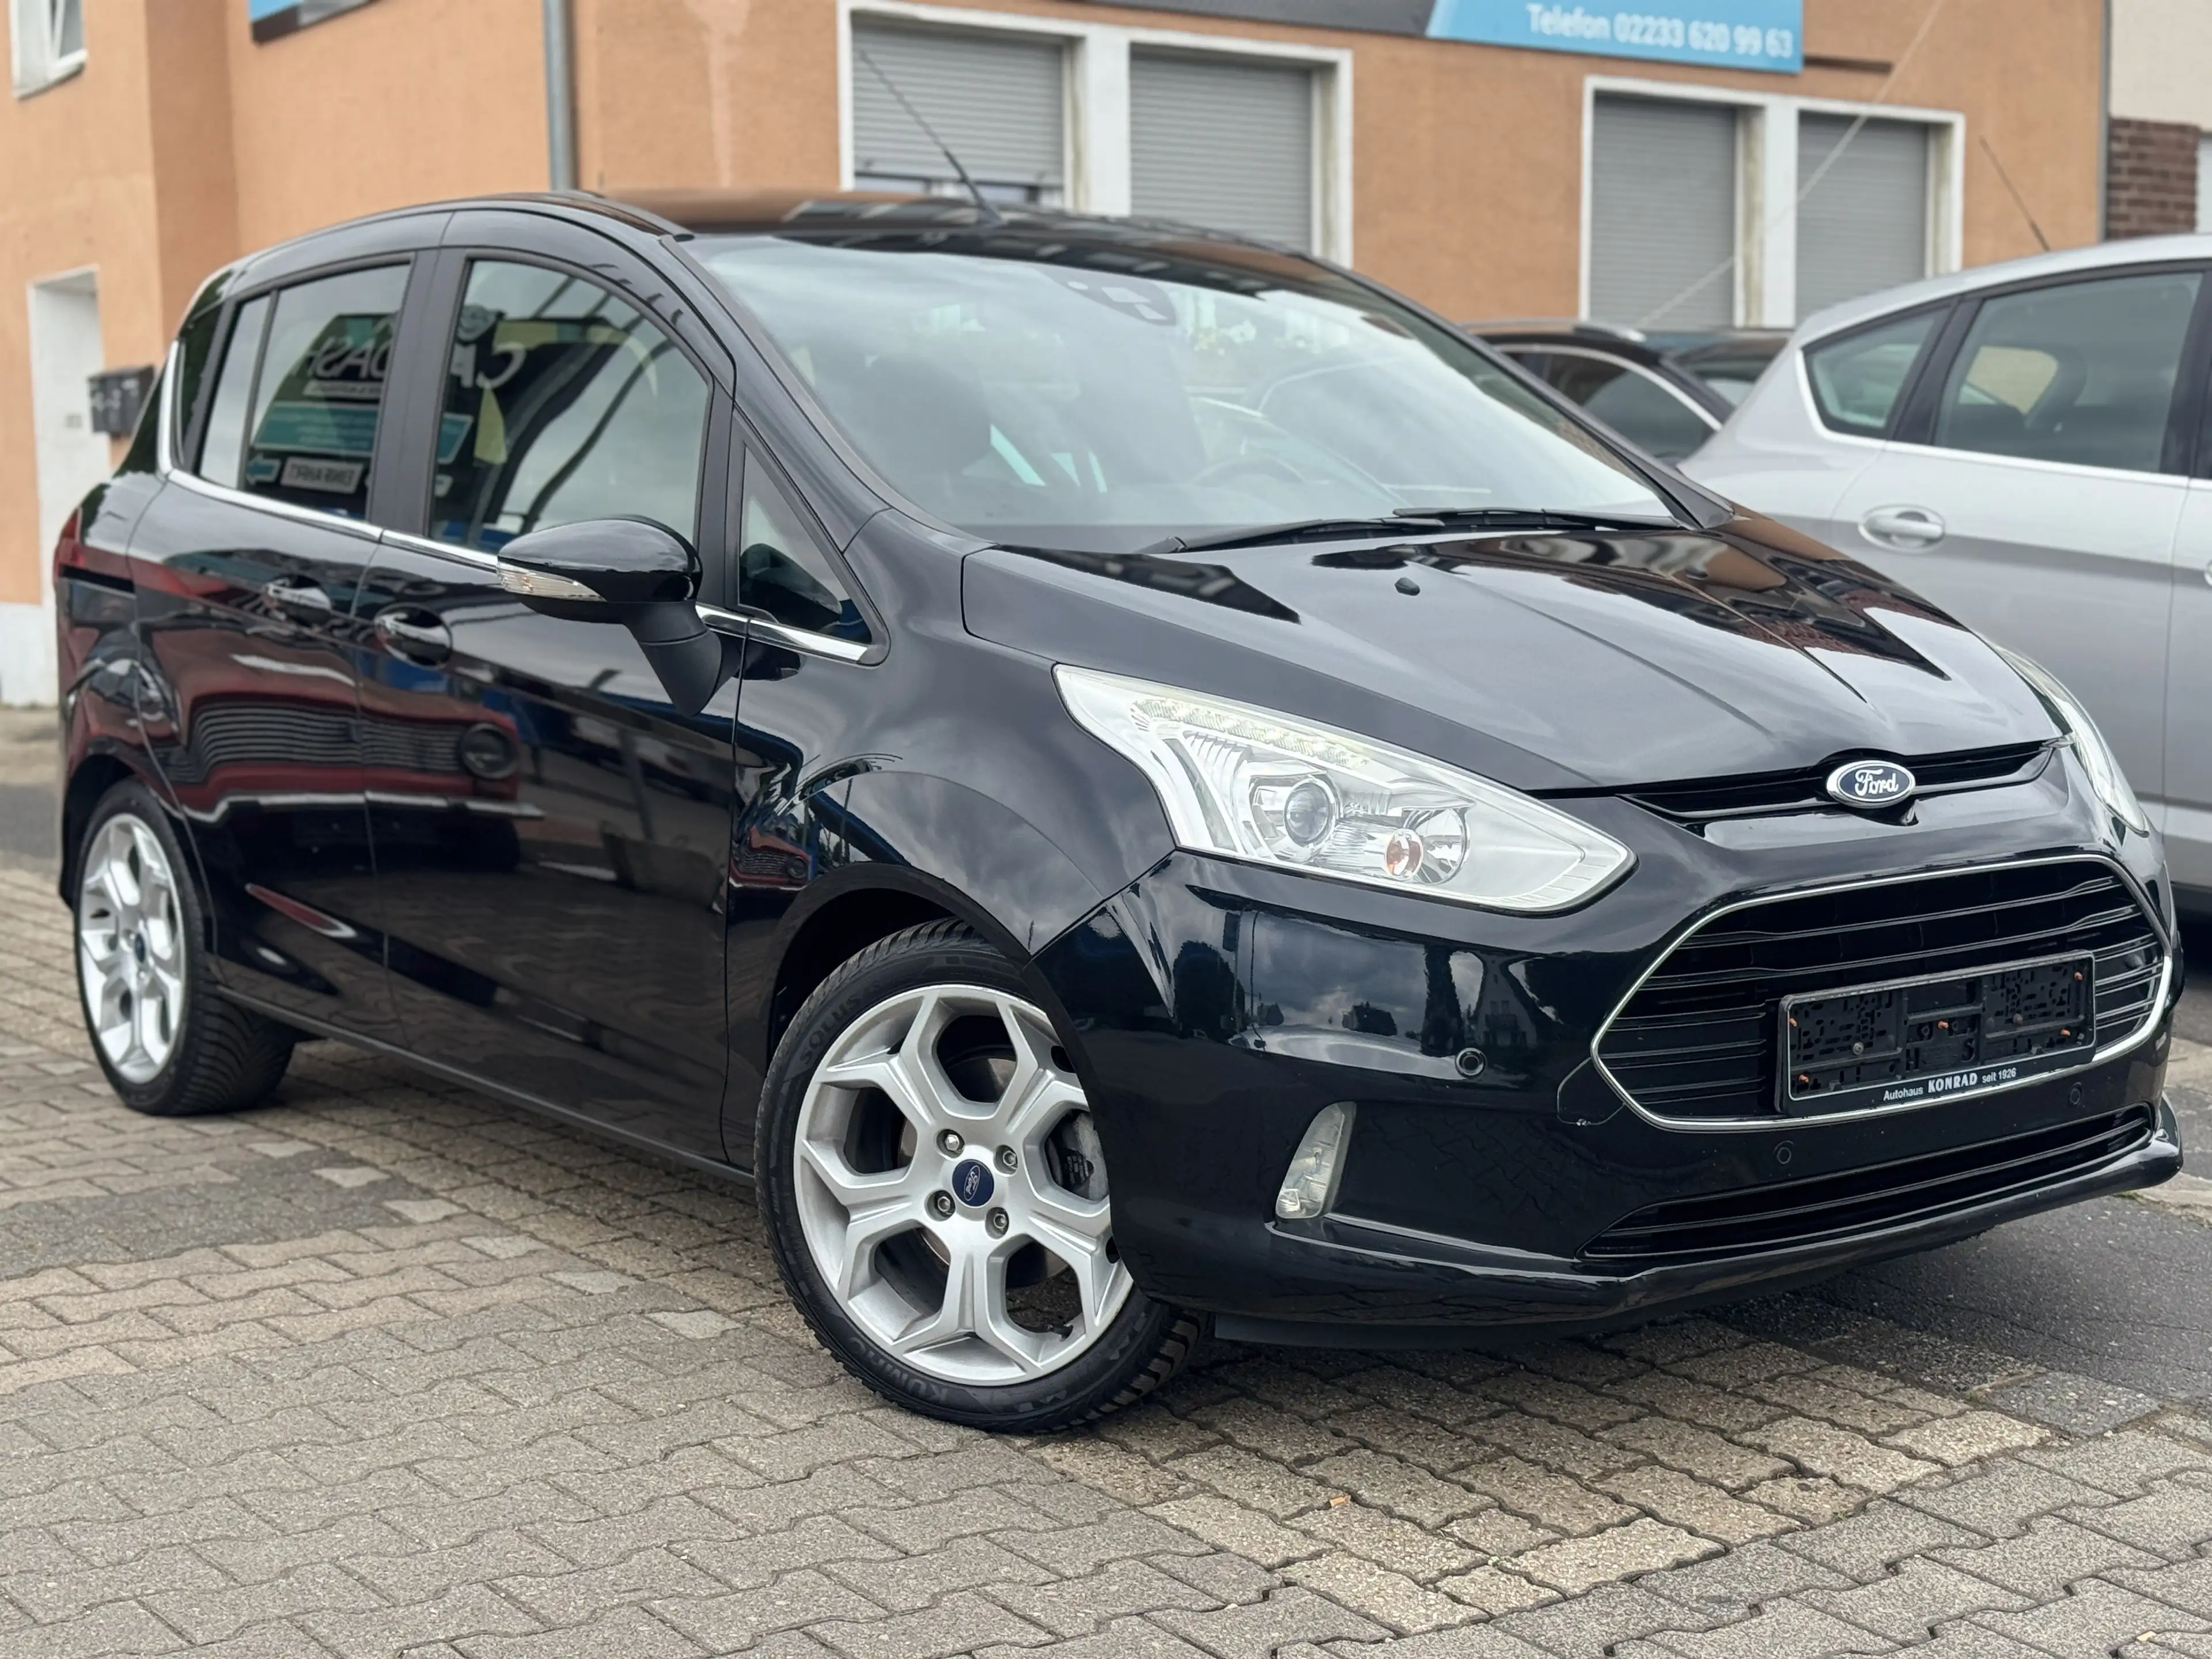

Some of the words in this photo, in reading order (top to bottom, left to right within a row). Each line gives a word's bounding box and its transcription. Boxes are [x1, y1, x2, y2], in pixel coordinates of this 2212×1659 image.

[1527, 3, 1611, 41] Telefon
[1614, 12, 1685, 48] 02233
[1688, 20, 1730, 52] 620
[1733, 24, 1762, 56] 99
[1765, 28, 1793, 58] 63
[1855, 768, 1899, 796] Ford
[1883, 1086, 1923, 1101] Autohaus
[1928, 1073, 1978, 1093] KONRAD
[1982, 1073, 1997, 1083] seit
[1998, 1067, 2016, 1080] 1926
[965, 1171, 978, 1195] Ford
